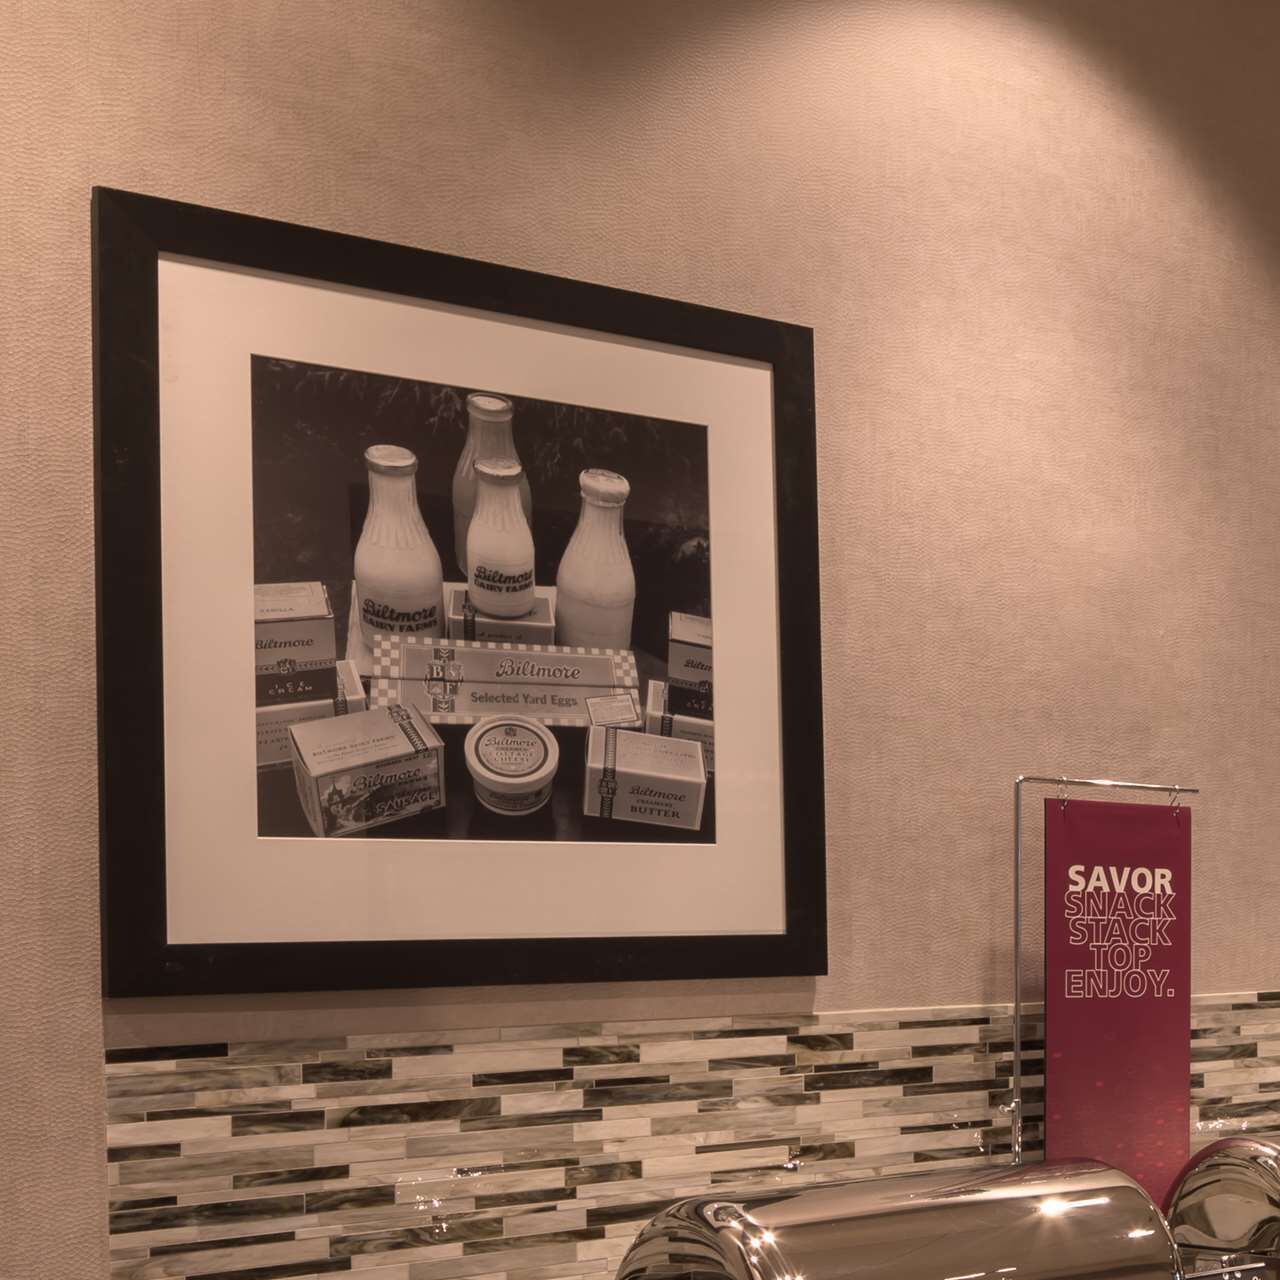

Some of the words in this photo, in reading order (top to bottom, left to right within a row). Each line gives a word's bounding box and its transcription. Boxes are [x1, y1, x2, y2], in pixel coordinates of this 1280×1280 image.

[474, 566, 533, 585] Biltmore
[362, 598, 437, 622] Biltmore
[496, 658, 582, 679] Biltmore
[470, 692, 520, 704] Selected
[522, 693, 547, 705] Yard
[550, 694, 578, 707] Eggs
[350, 768, 421, 794] Biltmore
[629, 785, 687, 802] Biltmore
[630, 805, 681, 819] BUTTER
[1068, 865, 1173, 894] SAVOR
[1064, 890, 1176, 920] SNACK
[1069, 917, 1172, 945] STACK
[1089, 943, 1152, 971] TOP
[1065, 969, 1175, 998] ENJOY.
